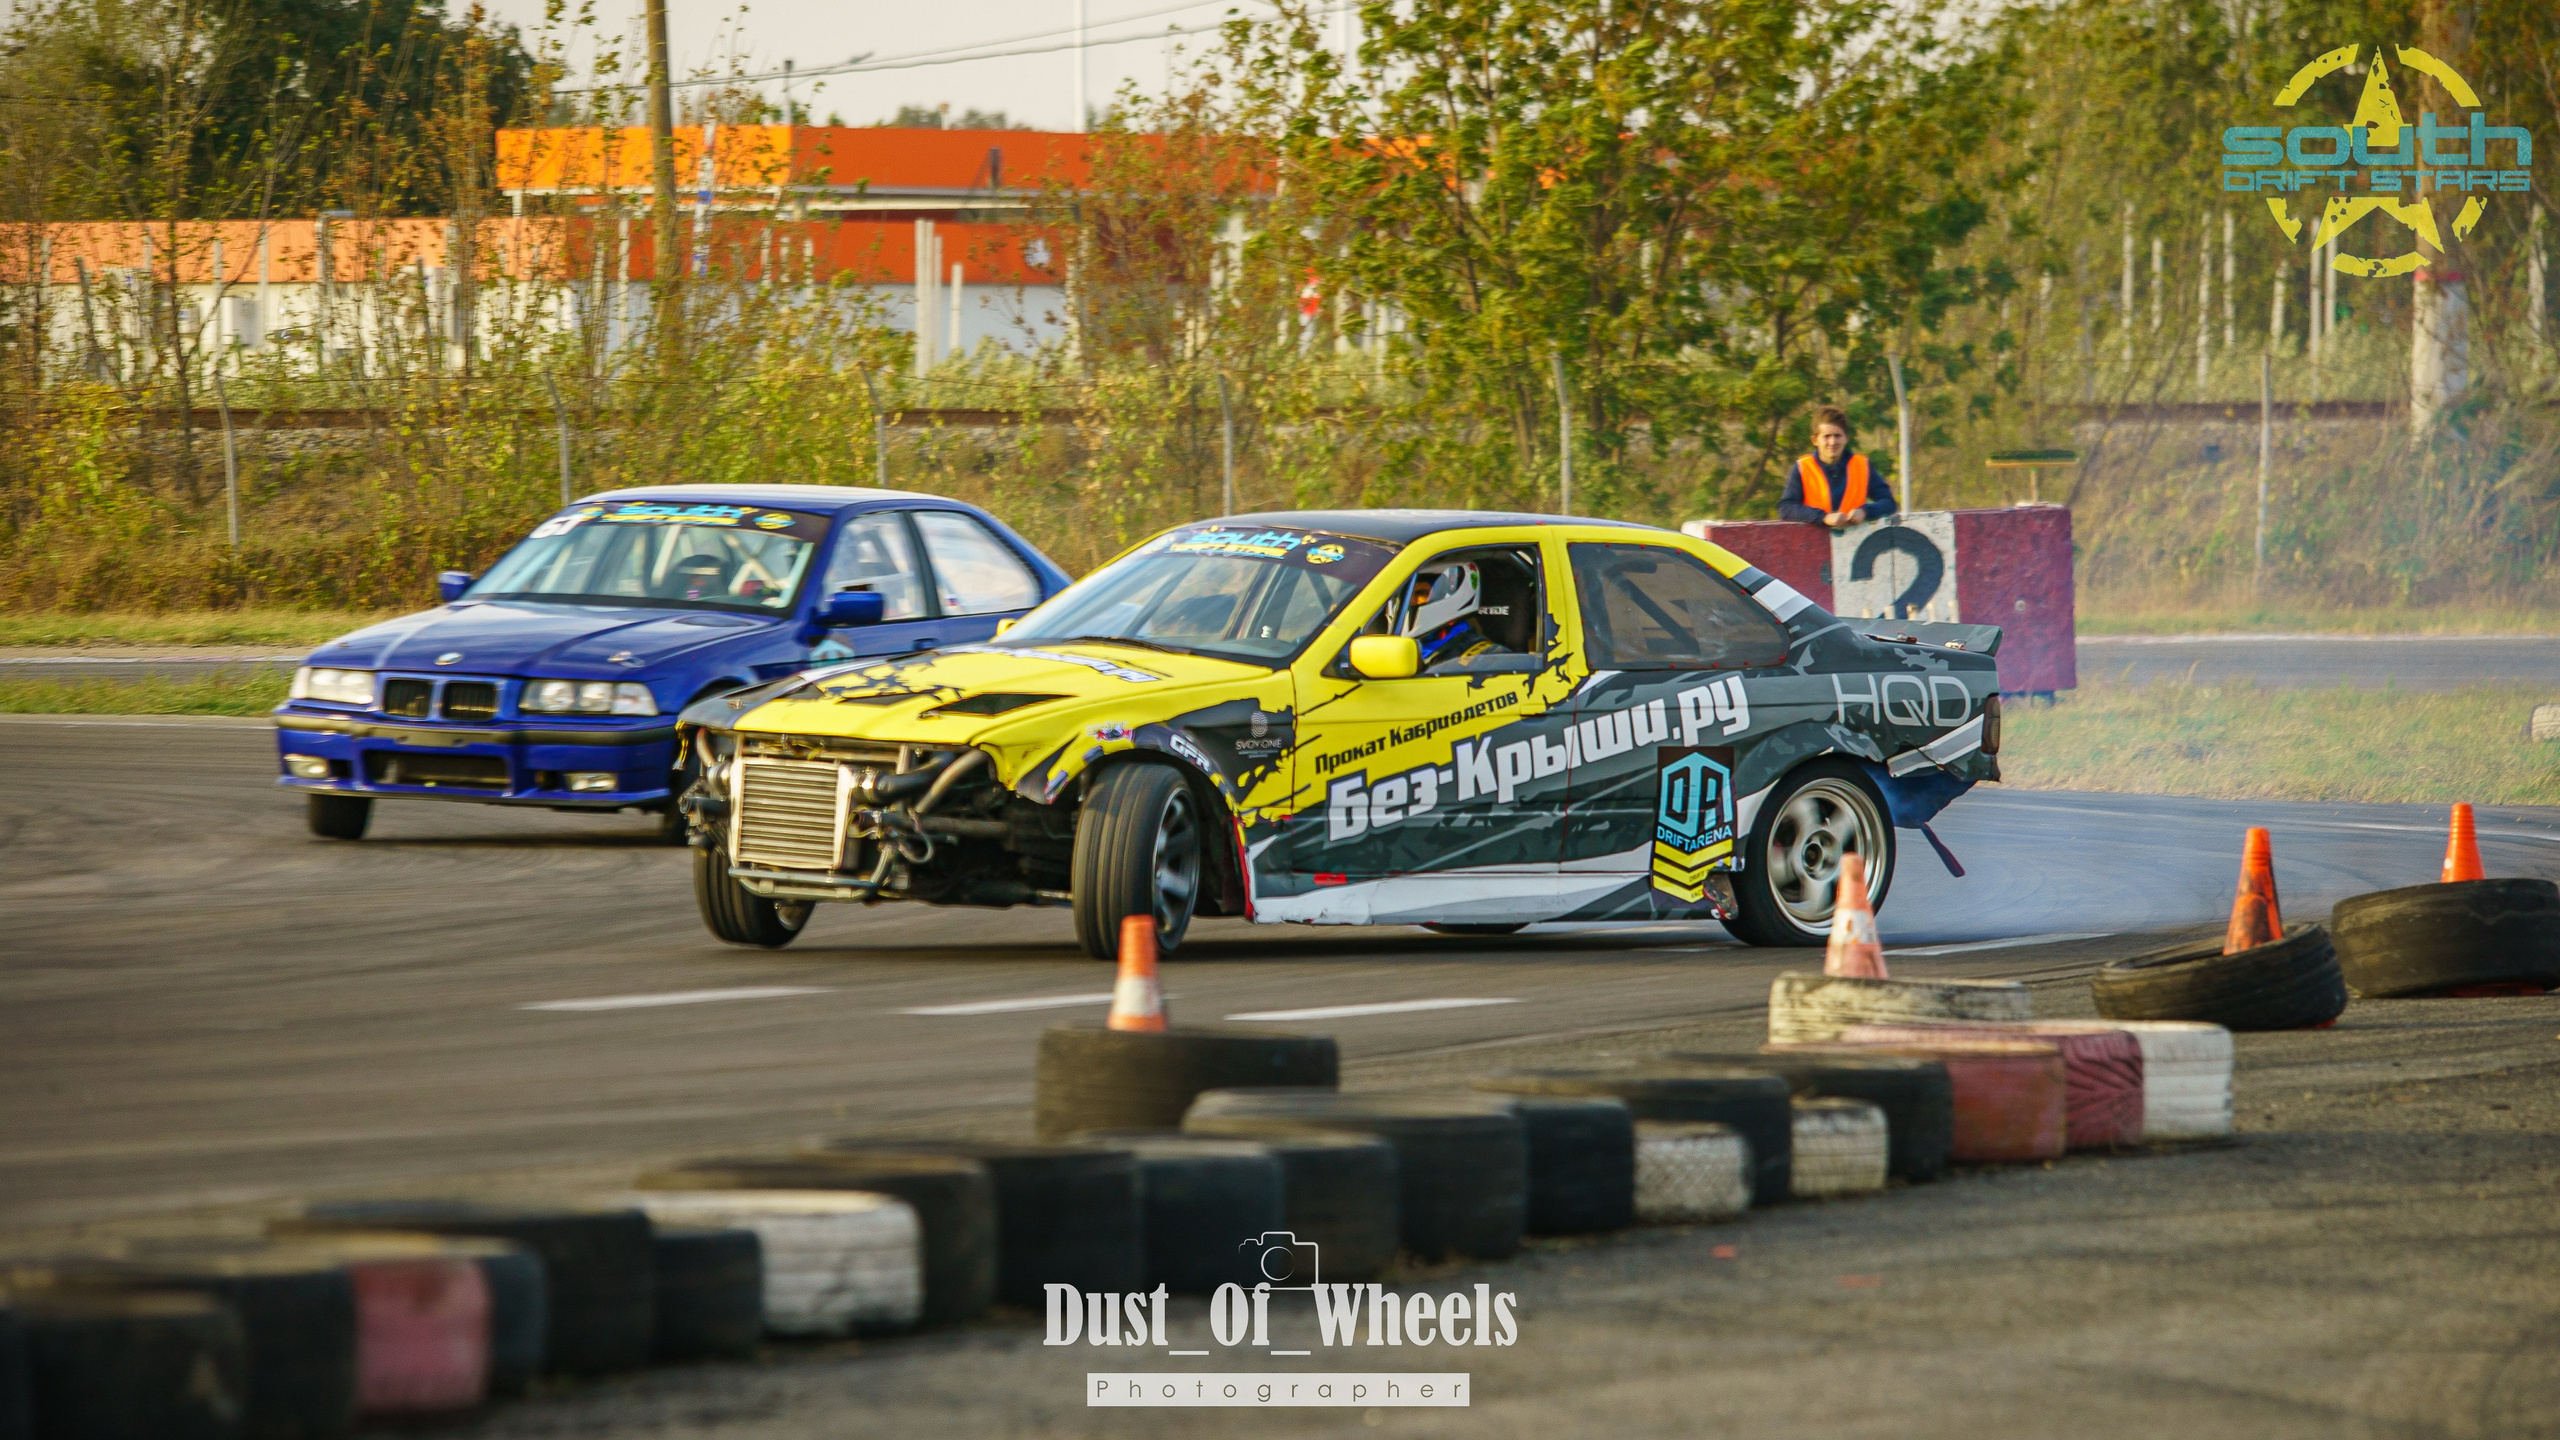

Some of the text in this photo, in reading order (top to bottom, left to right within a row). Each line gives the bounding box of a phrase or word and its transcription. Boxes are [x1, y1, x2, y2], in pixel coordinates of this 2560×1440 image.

[1850, 526, 1944, 620] 2
[1315, 690, 1519, 775] Прокат Кабриолетов
[1831, 674, 1971, 728] HQD
[1169, 733, 1211, 772] GPR
[1327, 674, 1751, 842] Без-Крыши.ру
[1656, 825, 1733, 852] DRIFTARENA
